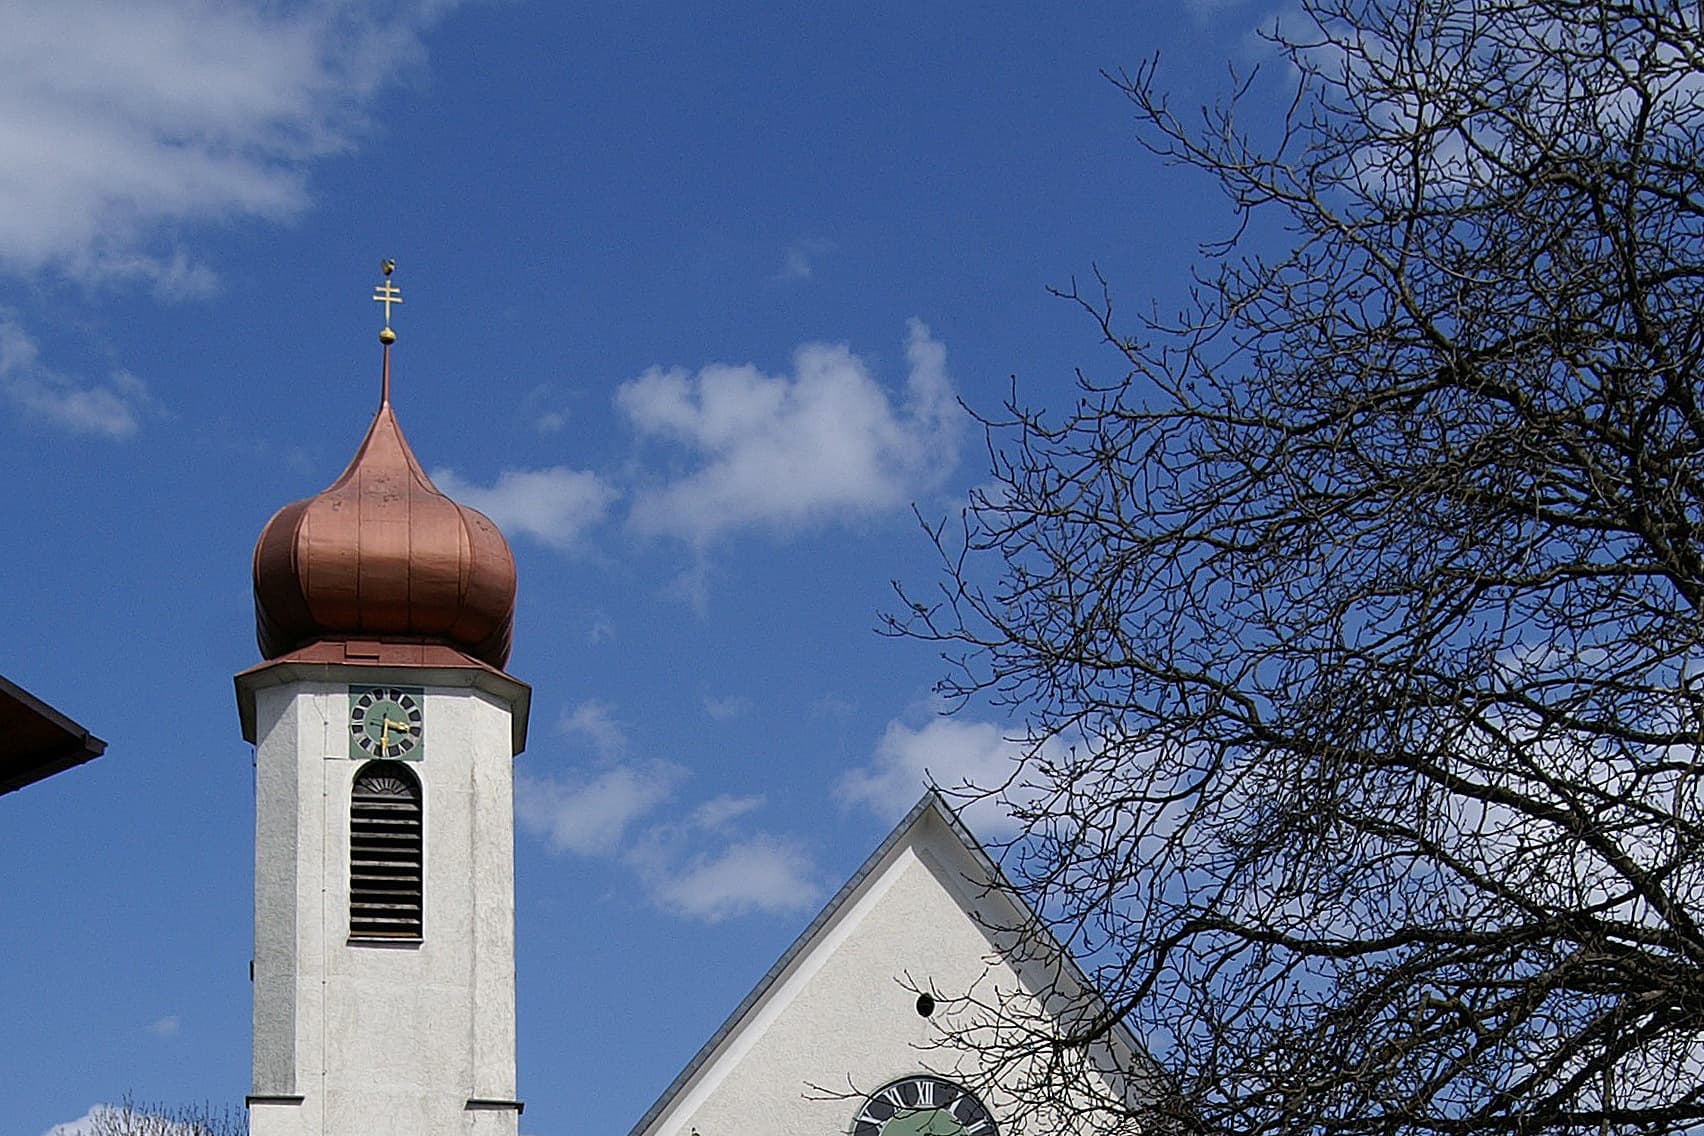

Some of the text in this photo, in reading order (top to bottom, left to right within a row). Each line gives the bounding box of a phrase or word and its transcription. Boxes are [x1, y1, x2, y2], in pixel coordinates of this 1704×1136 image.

[884, 1087, 906, 1111] XI
[916, 1081, 934, 1105] XII
[861, 1110, 886, 1128] X
[966, 1116, 988, 1135] II
